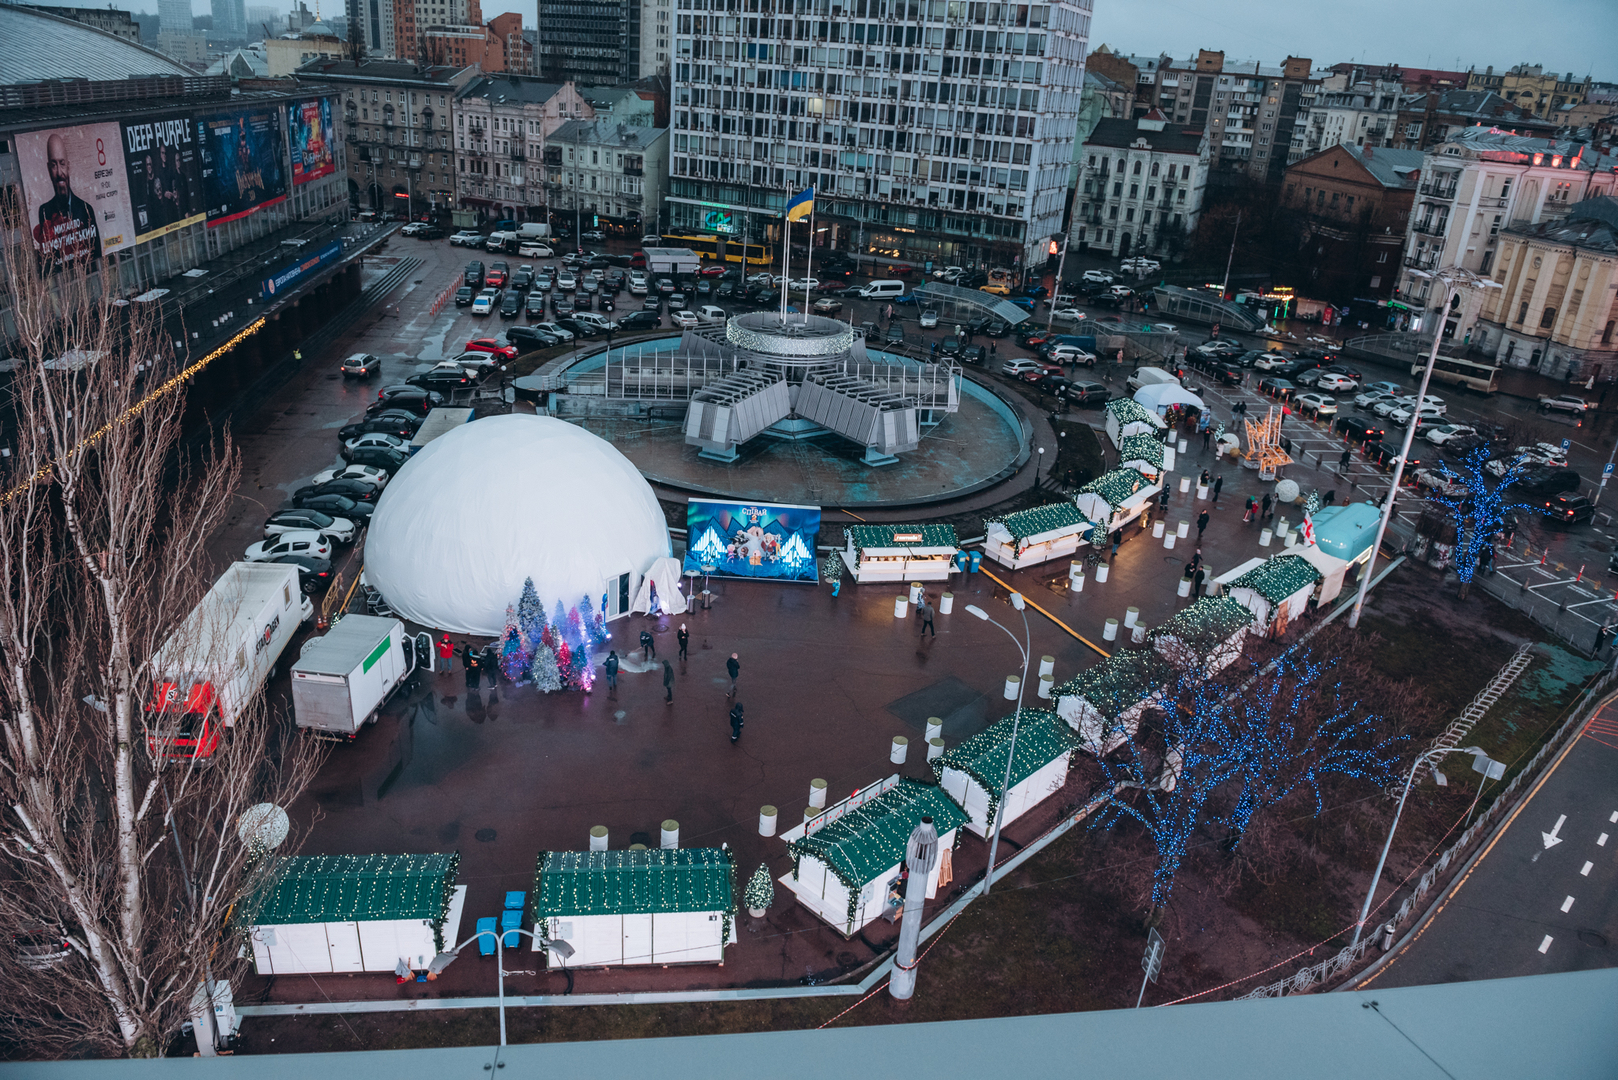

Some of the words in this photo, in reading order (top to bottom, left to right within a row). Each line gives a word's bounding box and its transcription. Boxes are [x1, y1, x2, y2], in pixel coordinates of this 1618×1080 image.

[126, 123, 153, 153] DEEP
[154, 118, 191, 150] PURPLE
[96, 138, 106, 166] 8
[94, 168, 113, 179] БЕРЕЗНЯ
[53, 218, 81, 235] МИХАЙЛО
[42, 224, 97, 254] ШУФУТИНСЬКИЙ
[1563, 440, 1569, 448] P
[1606, 464, 1613, 472] P
